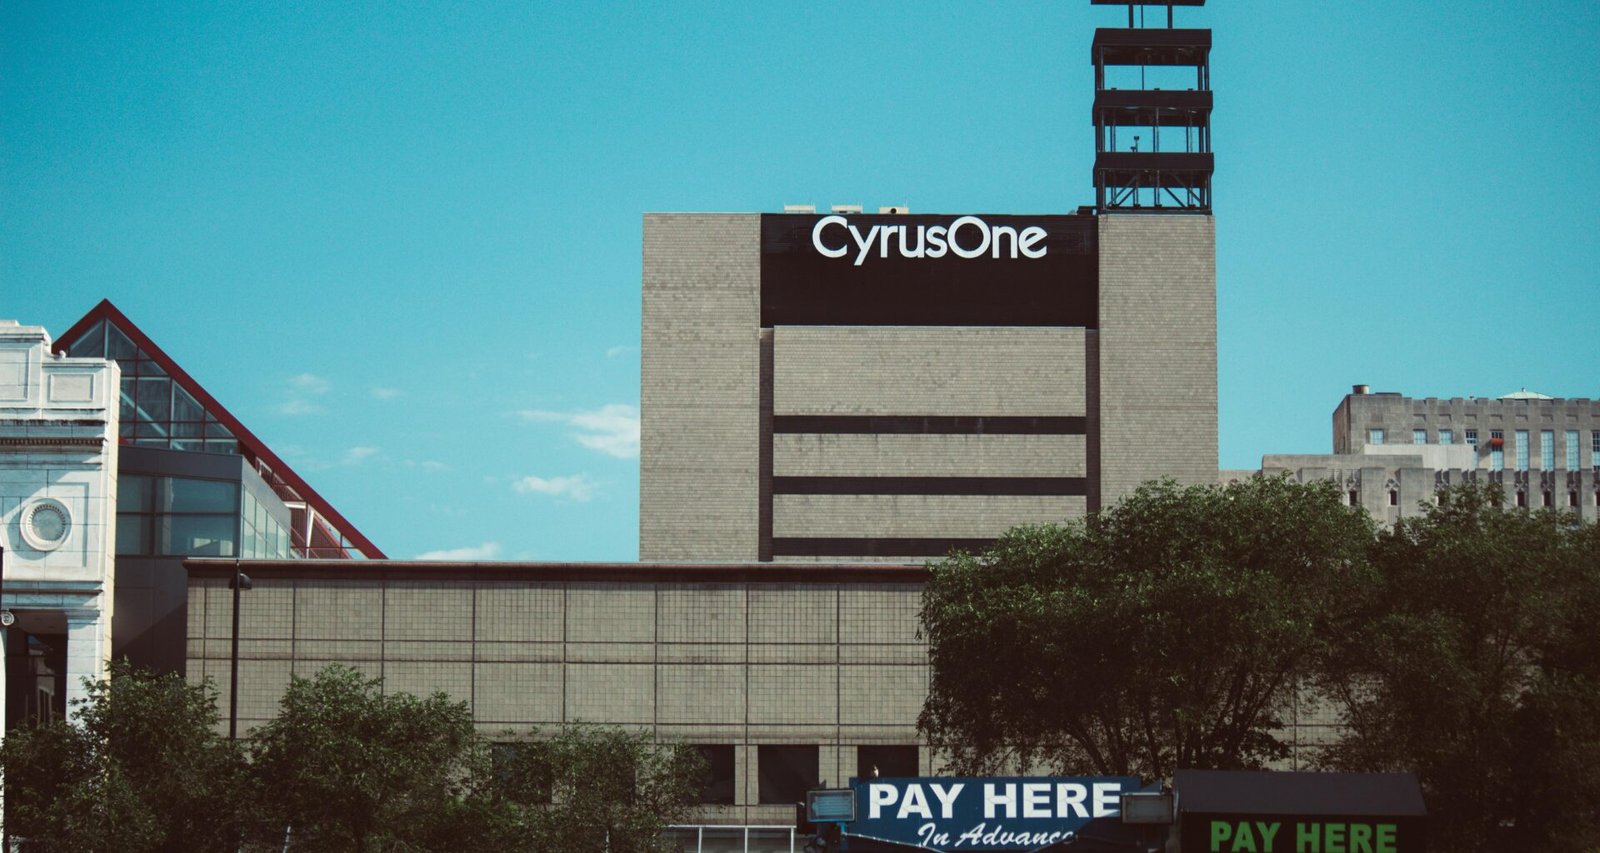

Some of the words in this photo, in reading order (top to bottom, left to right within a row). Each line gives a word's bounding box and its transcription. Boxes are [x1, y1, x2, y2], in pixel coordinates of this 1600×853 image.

[812, 215, 1048, 266] CyrusOne
[868, 783, 965, 819] PAY
[983, 783, 1121, 819] HERE
[917, 822, 950, 847] In
[1210, 821, 1281, 853] PAY
[1296, 823, 1397, 853] HERE
